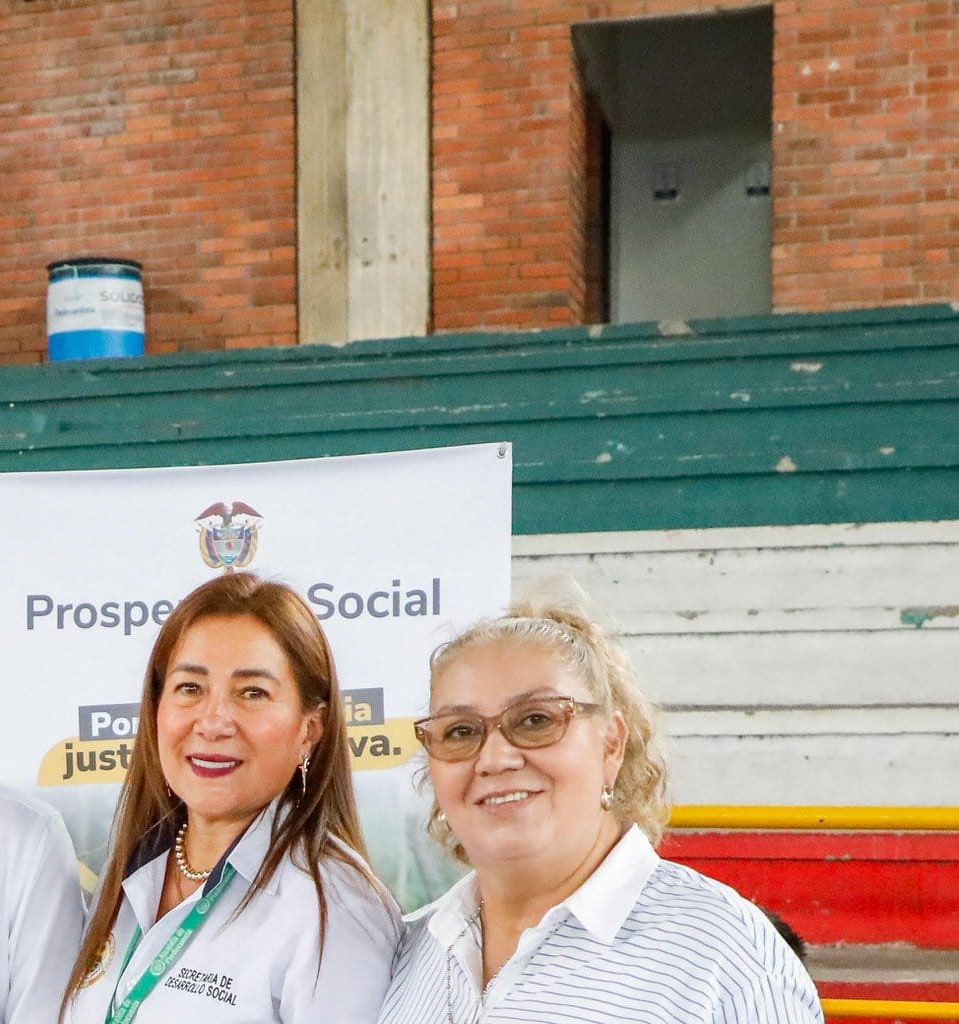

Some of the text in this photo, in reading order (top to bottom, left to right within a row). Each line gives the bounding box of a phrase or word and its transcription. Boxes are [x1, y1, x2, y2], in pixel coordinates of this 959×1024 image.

[27, 578, 441, 636] Prospe Social
[62, 742, 132, 780] just
[164, 976, 237, 1006] DESARROLLO SOCIAL
[219, 975, 233, 990] DE
